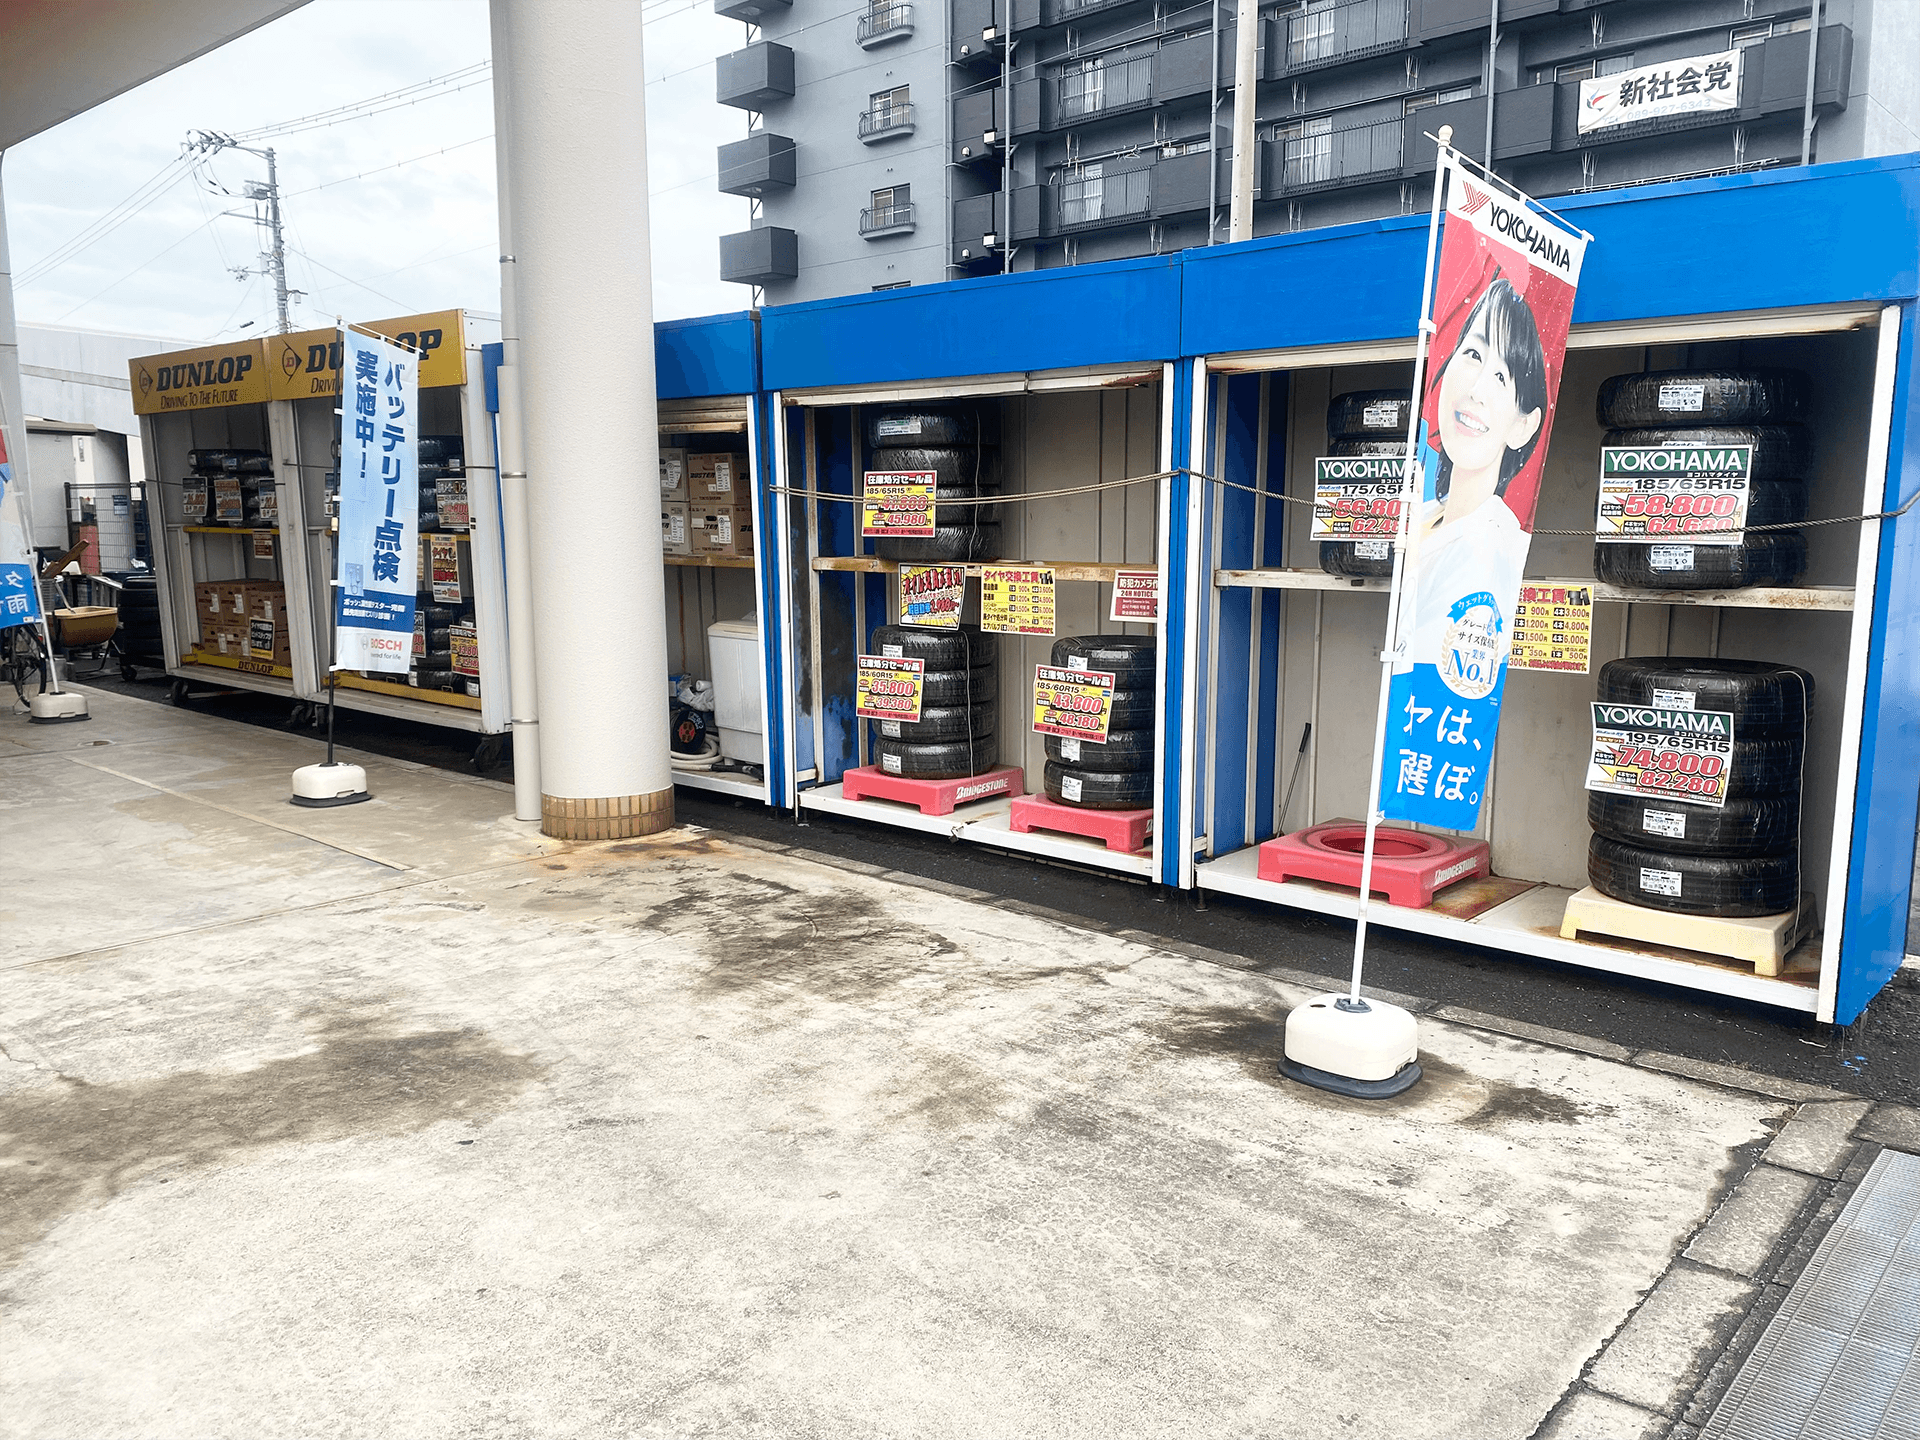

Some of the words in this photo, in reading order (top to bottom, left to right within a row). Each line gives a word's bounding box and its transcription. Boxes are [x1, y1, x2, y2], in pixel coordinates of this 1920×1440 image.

[1619, 61, 1733, 108] 新社会党
[1627, 98, 1712, 120] 089-927-6343
[1490, 201, 1571, 272] YOKOHAMA
[156, 355, 252, 392] DUNLOP
[355, 350, 378, 479] 実施中！
[1321, 460, 1412, 479] YOKOHAM
[1609, 450, 1743, 471] YOKOHAMA
[372, 361, 406, 583] バッテリー点検
[867, 474, 933, 485] 在庫処分セール品
[1342, 485, 1414, 495] 175/65R1
[1634, 479, 1746, 490] 185/65R15
[1335, 499, 1402, 517] 56,80
[984, 570, 1039, 583] タイヤ交換工賃
[1520, 587, 1566, 604] 換工賃
[238, 661, 274, 674] DUNLOP
[860, 658, 920, 672] 在庫処分セール品
[1444, 648, 1494, 685] No.1
[859, 670, 893, 679] 185/60R15
[1039, 669, 1111, 687] 在庫処分セール品
[1037, 682, 1079, 693] 185/60R15
[1598, 706, 1726, 734] YOKOHAMA
[1626, 732, 1730, 753] 195/65R15
[1674, 731, 1723, 741] ヨコハマタイヤ
[955, 778, 1008, 800] BRIDGESTONE
